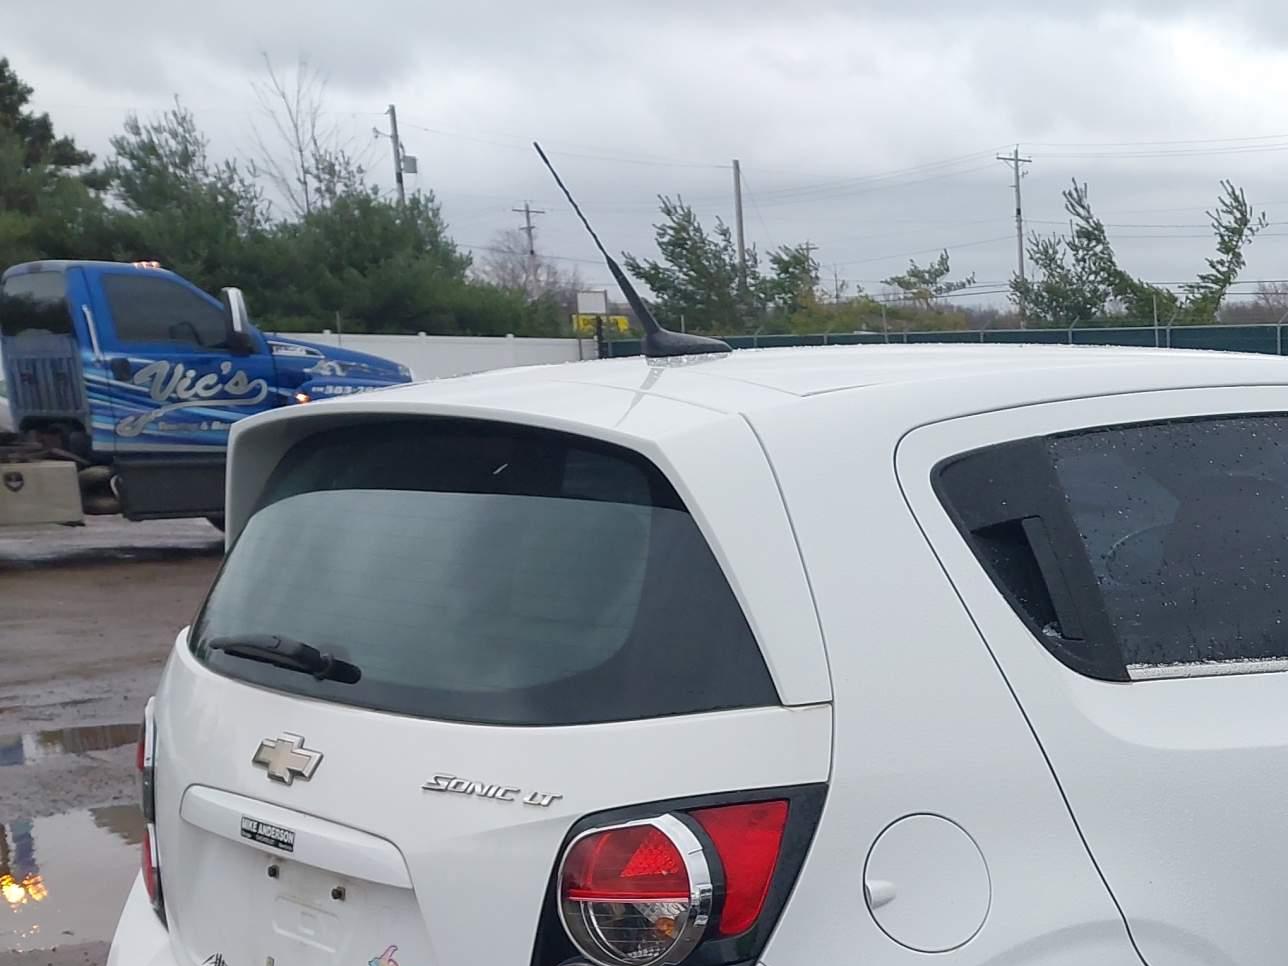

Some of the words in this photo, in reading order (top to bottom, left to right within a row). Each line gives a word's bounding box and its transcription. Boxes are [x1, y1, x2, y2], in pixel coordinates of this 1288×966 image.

[130, 360, 268, 410] Vic's
[421, 774, 521, 802] SONIC
[522, 791, 563, 807] LT
[241, 818, 258, 833] MIKE
[257, 823, 294, 846] ANDERSON
